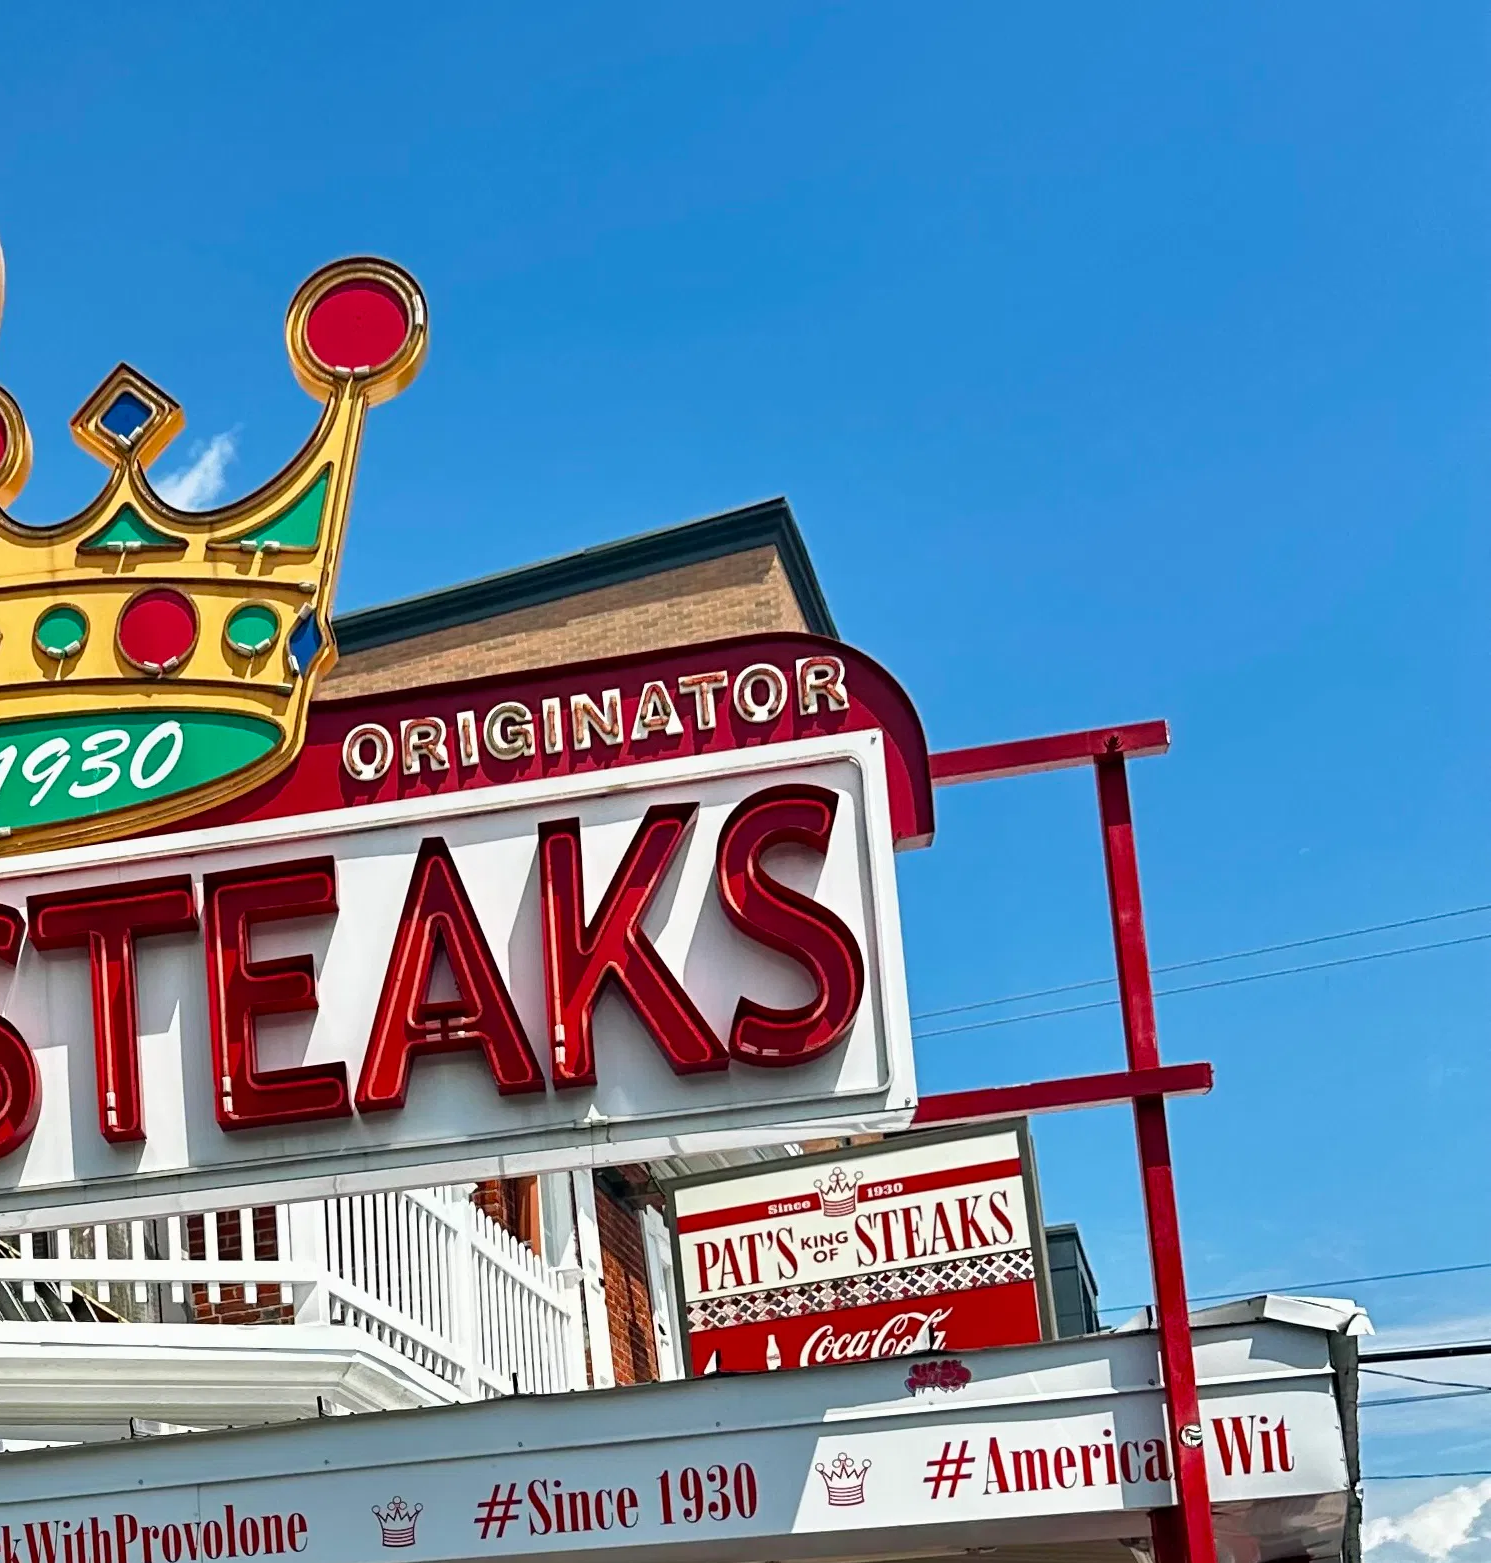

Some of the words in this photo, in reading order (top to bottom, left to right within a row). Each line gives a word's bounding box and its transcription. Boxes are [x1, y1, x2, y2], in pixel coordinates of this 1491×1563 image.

[341, 655, 850, 782] ORIGINATOR
[767, 1200, 812, 1215] Since
[866, 1181, 904, 1199] 1930
[854, 1190, 1015, 1268] STEAKS
[694, 1226, 799, 1293] PAT'S
[800, 1230, 849, 1251] KING
[813, 1247, 839, 1264] OF
[923, 1435, 1175, 1500] #America
[1210, 1414, 1296, 1476] Wit
[474, 1478, 641, 1541] #Since
[655, 1462, 758, 1525] 1930
